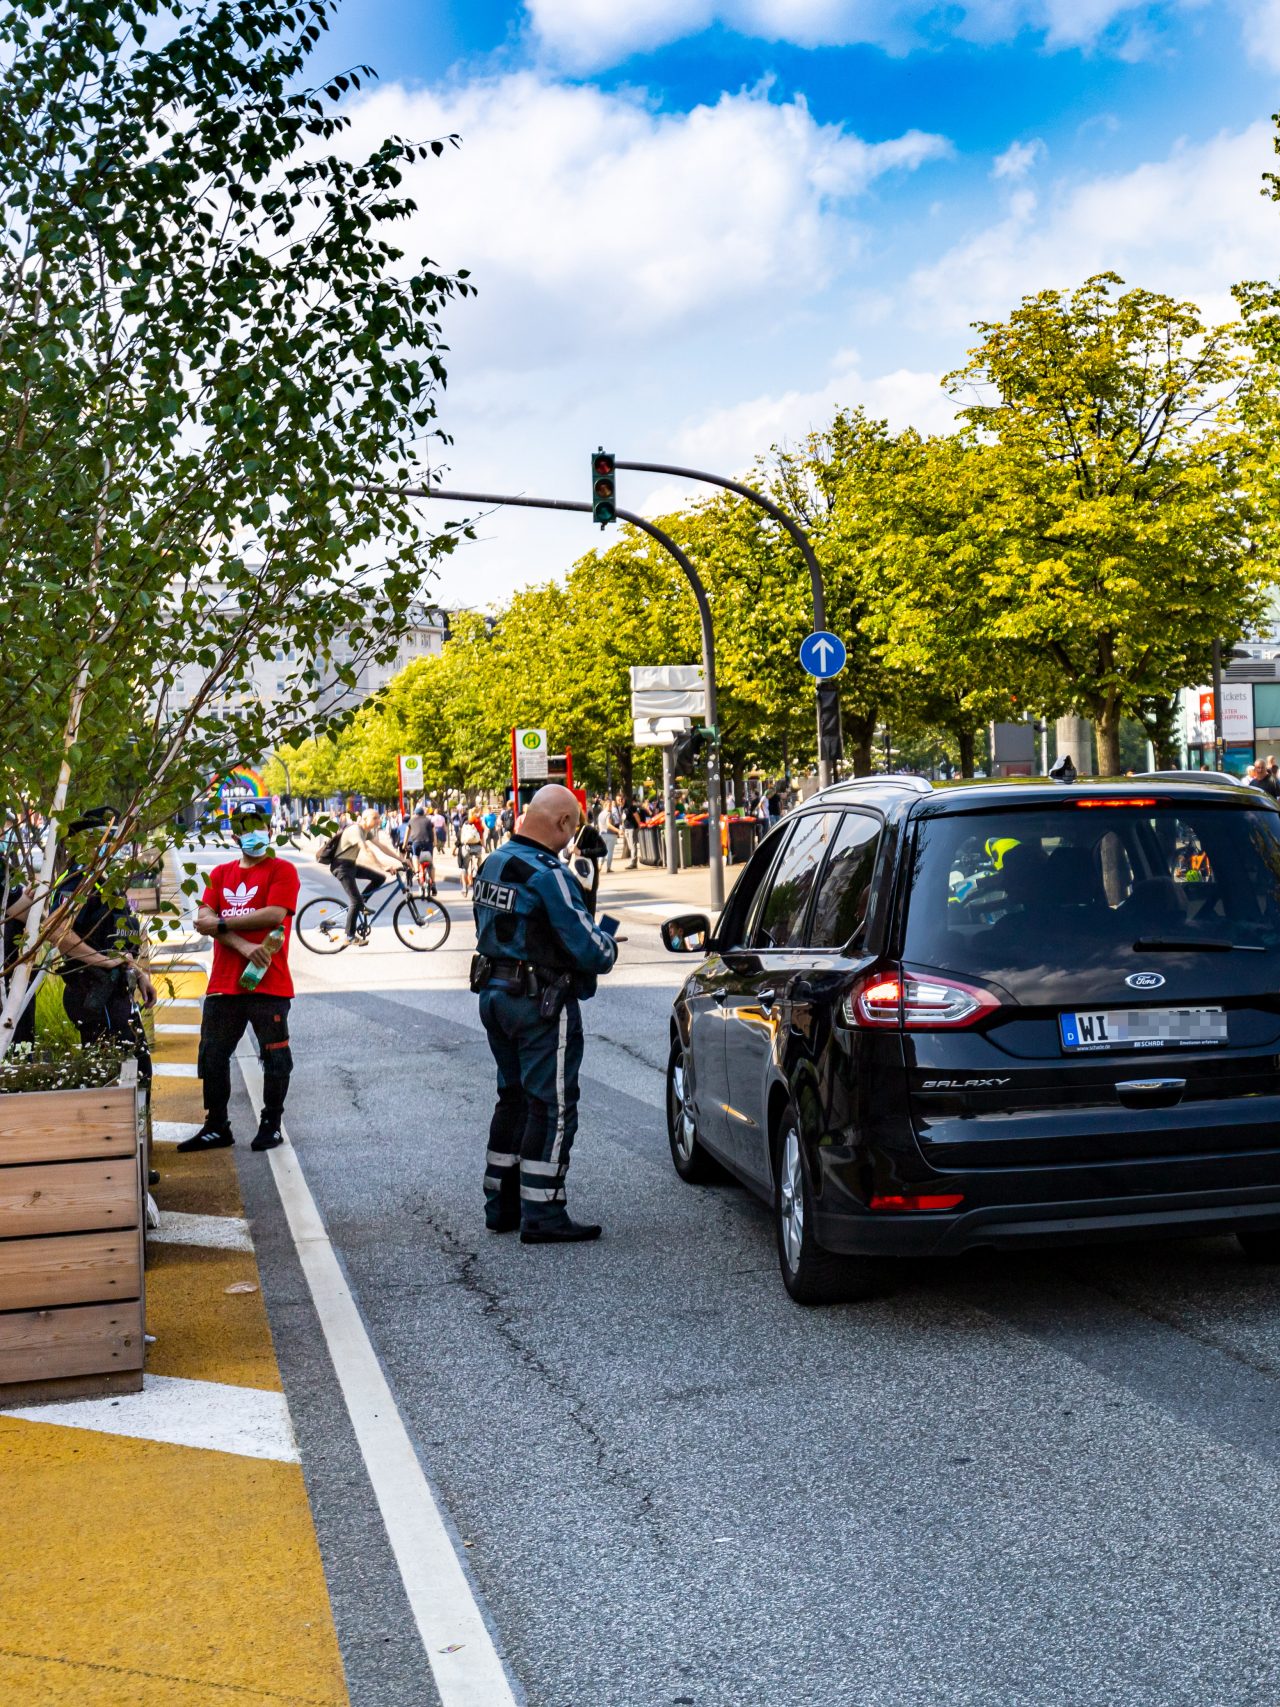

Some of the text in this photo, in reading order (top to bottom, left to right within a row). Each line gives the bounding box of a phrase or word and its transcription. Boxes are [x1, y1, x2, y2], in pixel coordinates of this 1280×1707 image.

[527, 735, 537, 745] H
[474, 880, 514, 910] OLIZEI
[1136, 975, 1156, 985] Ford
[1067, 1033, 1075, 1041] D
[922, 1078, 1011, 1088] GALAXY
